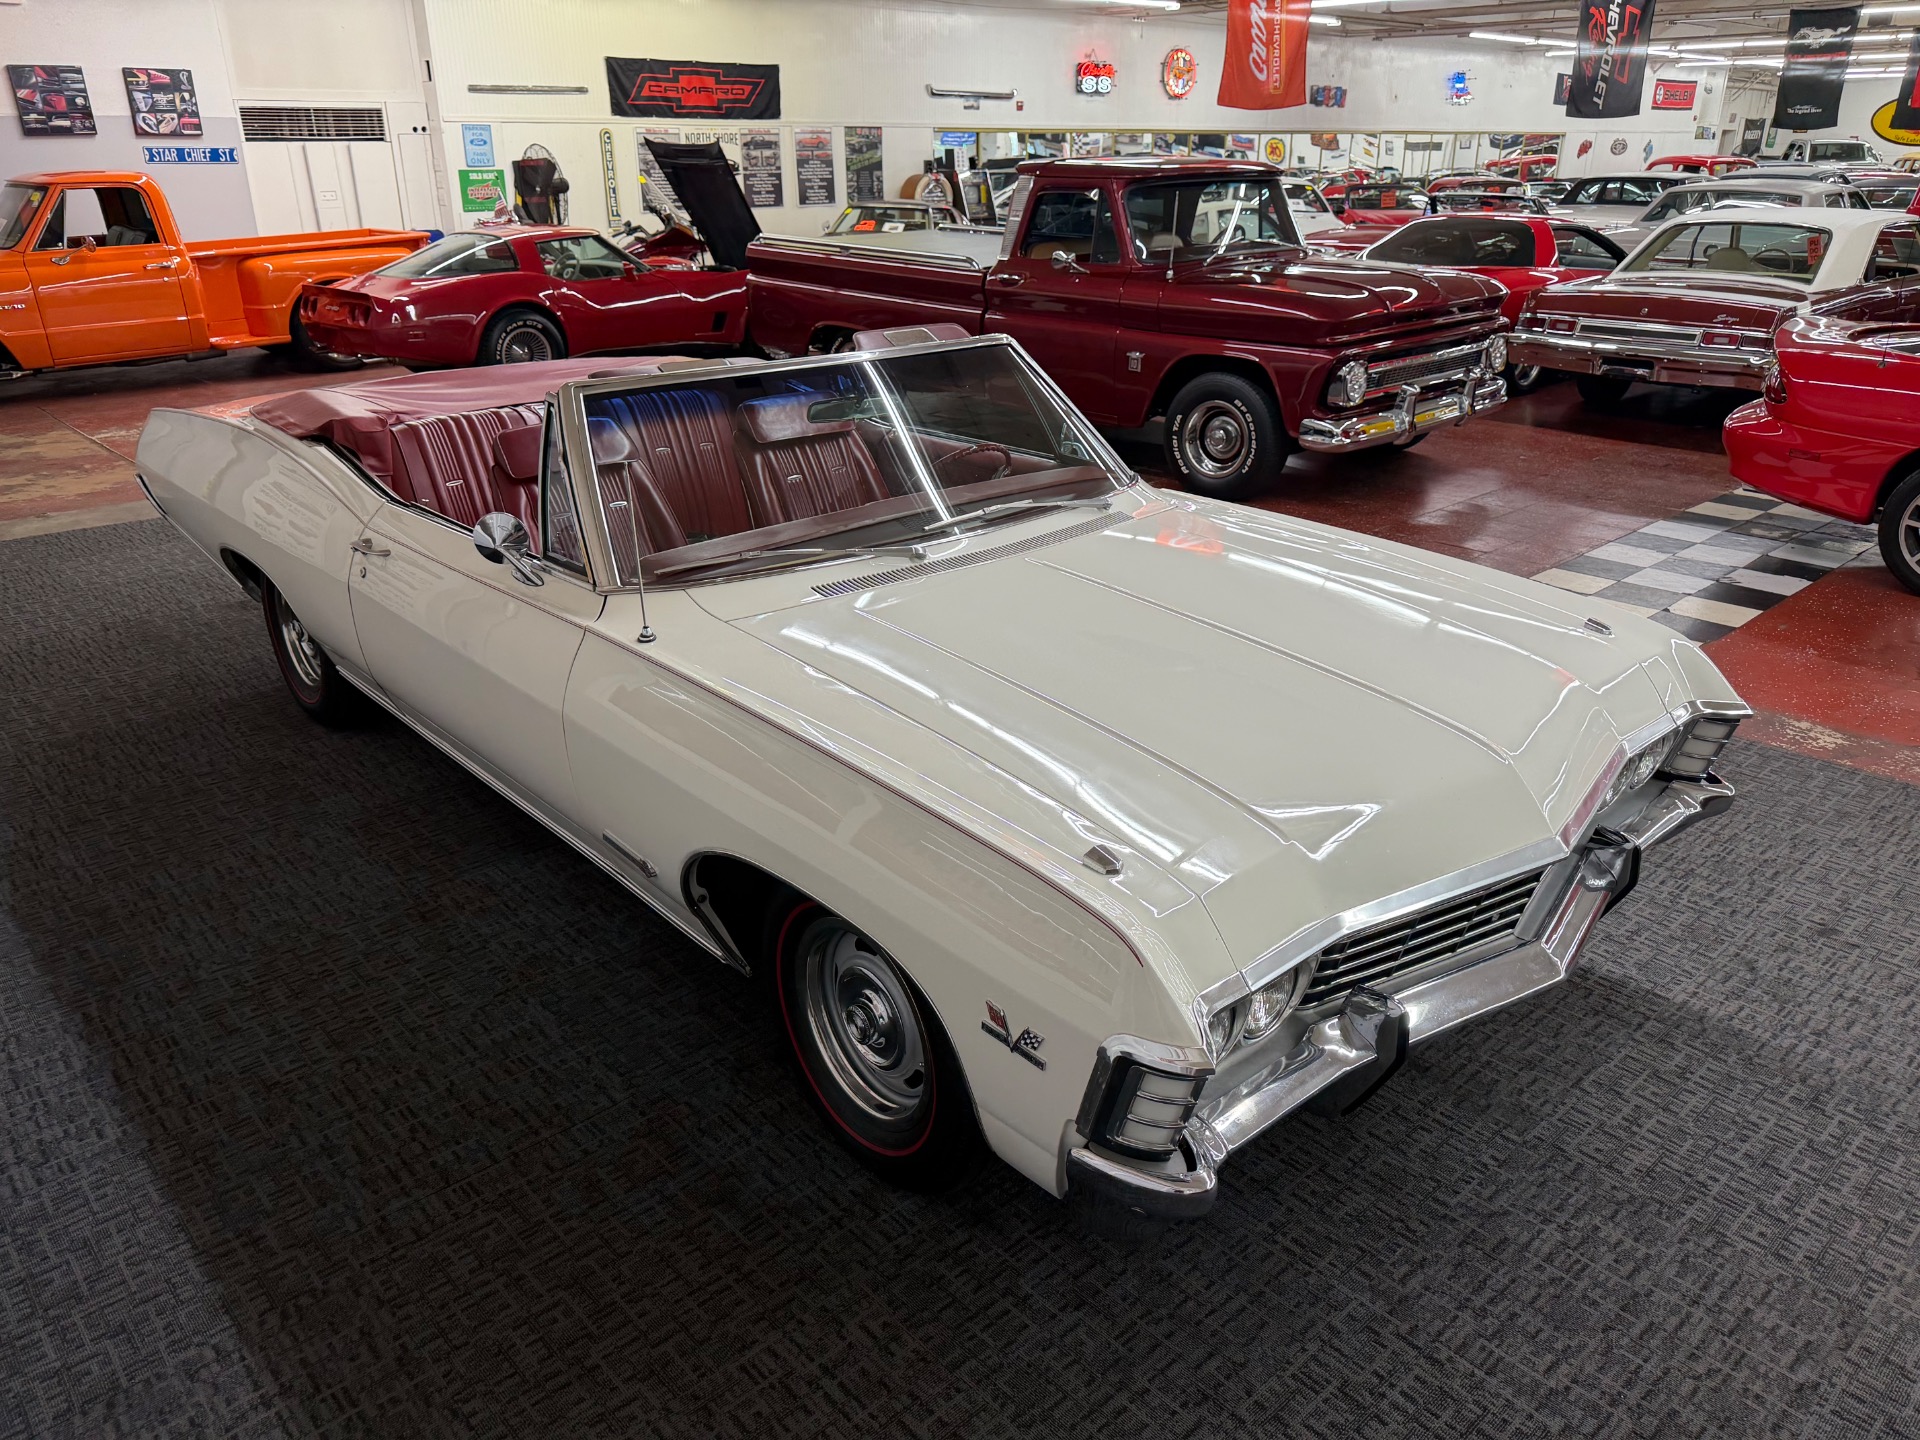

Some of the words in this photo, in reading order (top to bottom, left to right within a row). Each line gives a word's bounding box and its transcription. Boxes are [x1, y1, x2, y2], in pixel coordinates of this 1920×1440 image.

[1272, 18, 1281, 88] CHEVROLET
[1593, 0, 1622, 110] HEVROLET
[648, 84, 746, 96] CAMARO
[1081, 76, 1112, 93] SS
[1663, 88, 1694, 101] SHELBY
[685, 132, 711, 144] NORTH
[713, 132, 739, 146] SHORE
[152, 148, 179, 162] STAR
[184, 148, 212, 162] CHIEF
[218, 148, 231, 162] ST
[604, 132, 619, 216] CHEVROLET
